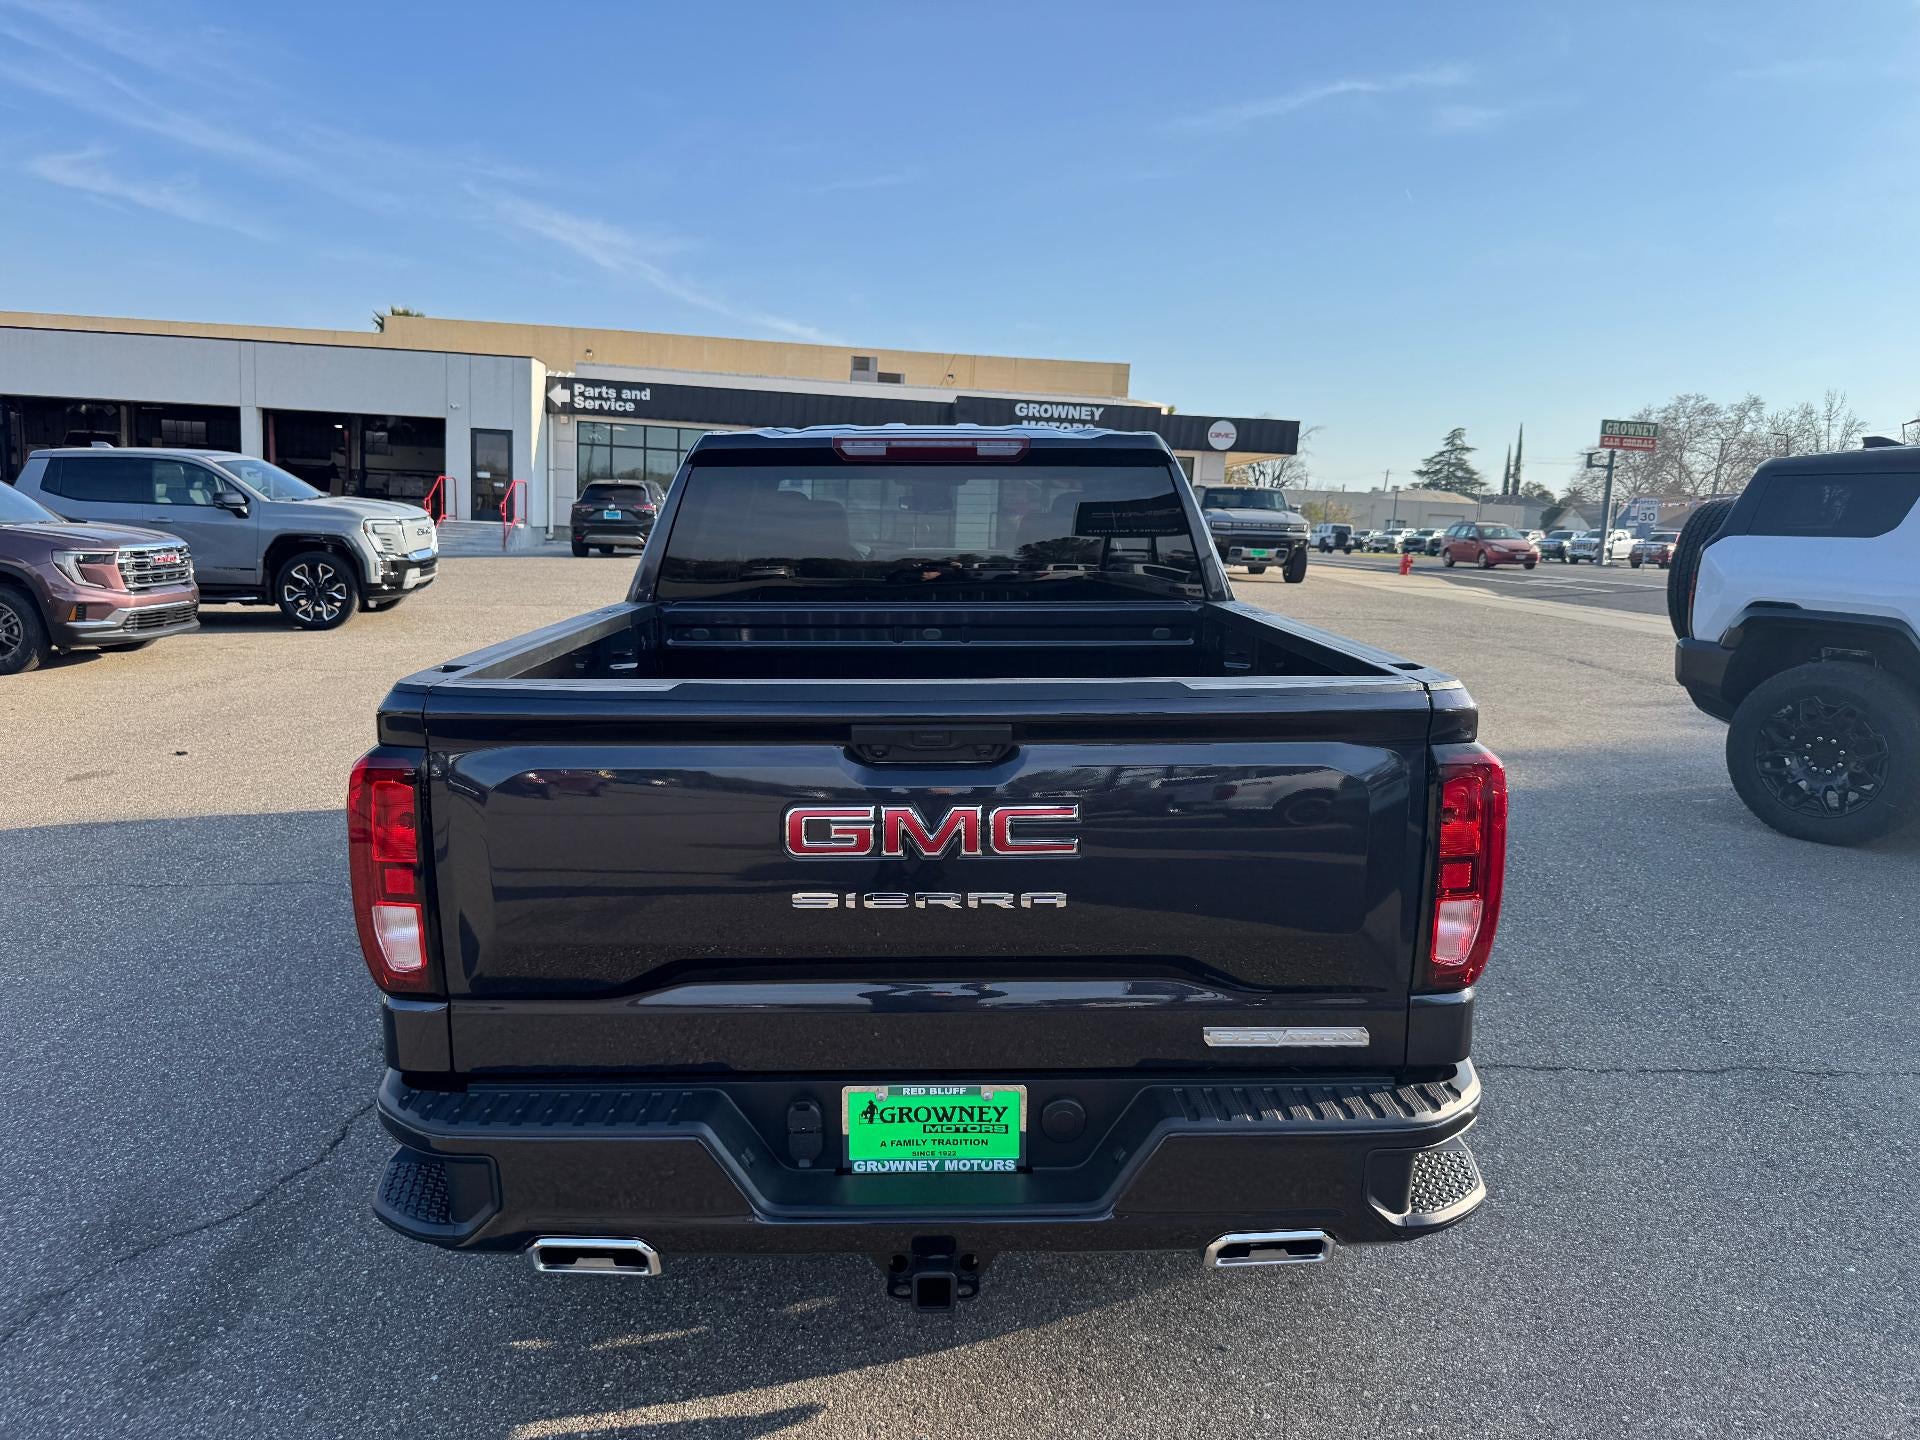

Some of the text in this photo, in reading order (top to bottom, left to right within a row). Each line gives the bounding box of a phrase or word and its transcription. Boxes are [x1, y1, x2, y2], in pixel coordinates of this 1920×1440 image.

[573, 383, 651, 401] Parts and
[573, 396, 636, 412] Service
[1014, 402, 1104, 420] GROWNEY
[1605, 422, 1656, 437] GROWNEY
[1603, 437, 1654, 448] CAR CORRAL
[1640, 512, 1656, 521] 30
[784, 804, 1080, 858] GMC
[791, 892, 1068, 909] SIERRA
[902, 1087, 967, 1096] RED BLUFF
[879, 1105, 1009, 1124] GROWNEY
[924, 1124, 1007, 1133] MOTORS
[880, 1138, 989, 1148] A FAMILY TRADITION
[853, 1159, 1016, 1172] GROWNEY MOTORS
